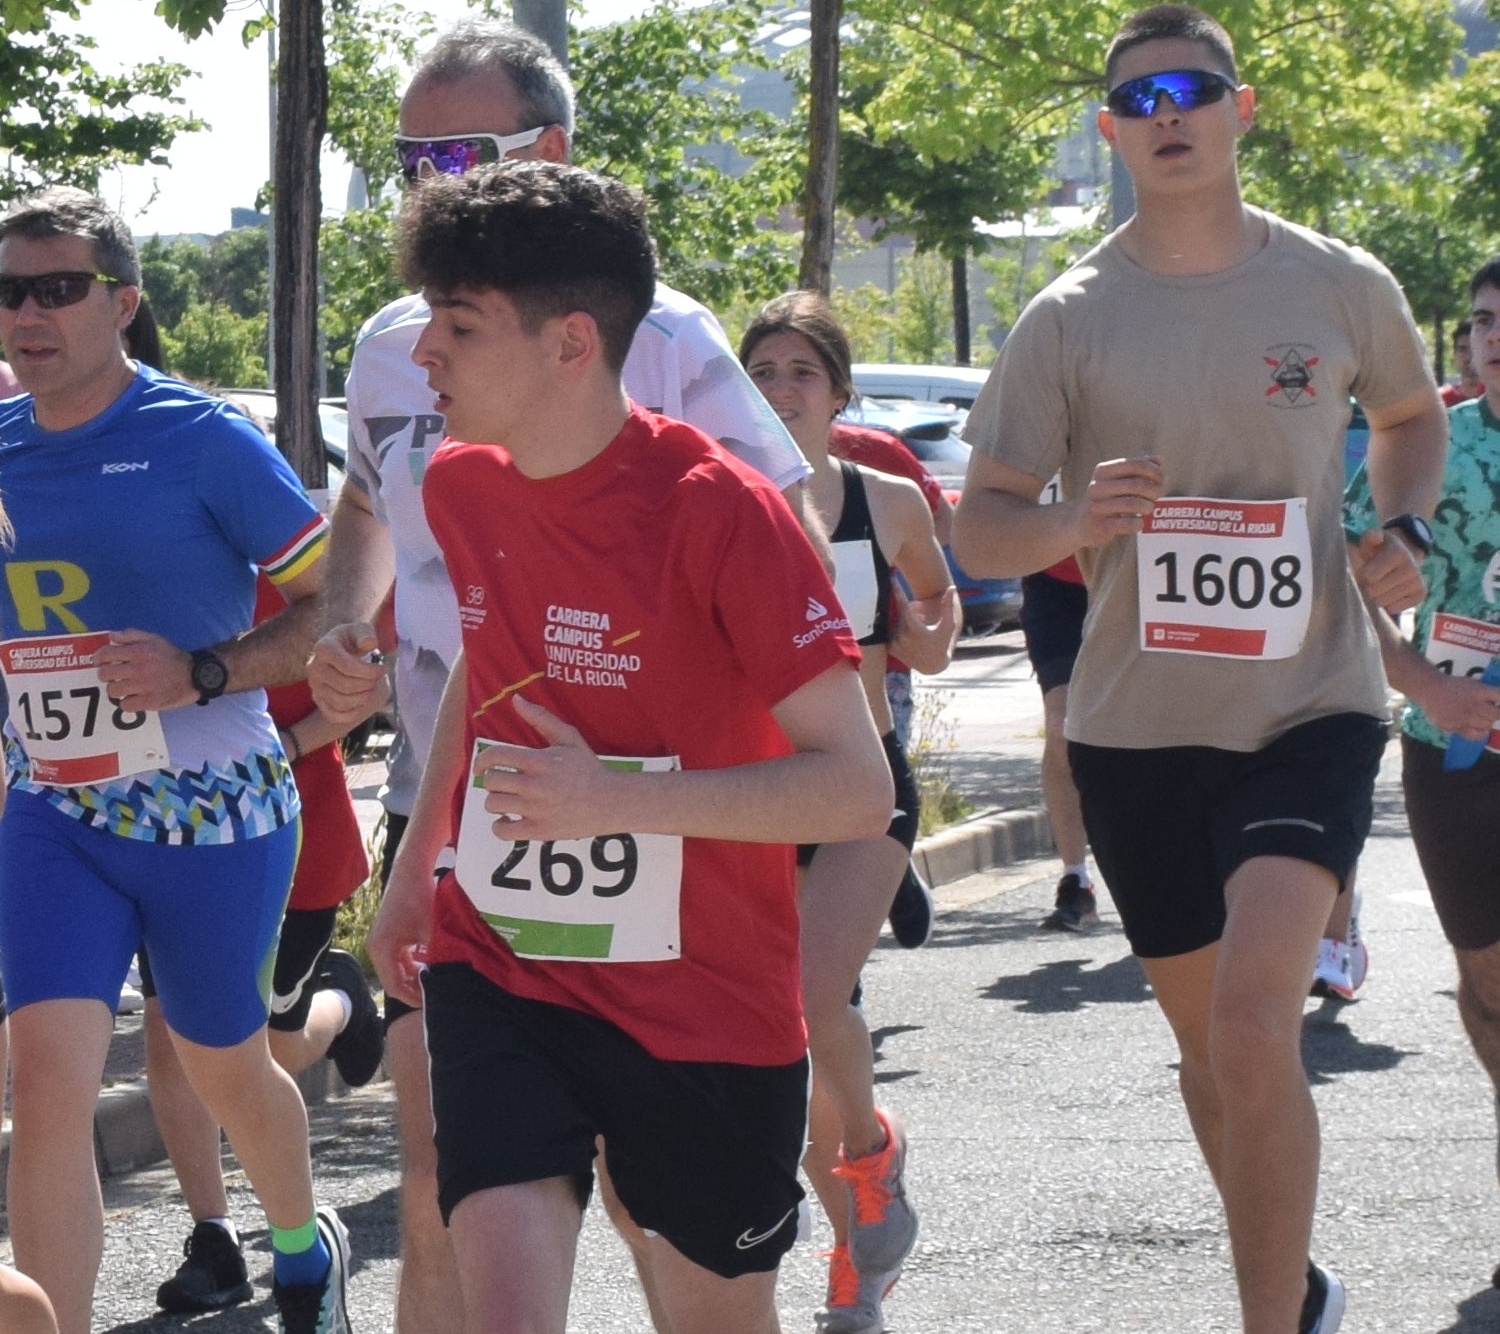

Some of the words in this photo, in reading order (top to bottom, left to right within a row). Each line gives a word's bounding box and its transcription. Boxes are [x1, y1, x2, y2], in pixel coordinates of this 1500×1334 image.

[1151, 519, 1218, 531] UNIVERSIDAD
[1219, 522, 1232, 533] DE
[1233, 523, 1246, 533] LA
[1247, 523, 1276, 534] RIOJA
[1153, 507, 1201, 519] CARRERA
[1202, 508, 1244, 521] CAMPUS
[1155, 551, 1302, 610] 1608
[5, 560, 90, 634] R
[547, 605, 611, 631] CARRERA
[42, 644, 74, 657] CAMPUS
[544, 624, 603, 650] CAMPUS
[545, 644, 641, 672] UNIVERSIDAD
[547, 662, 563, 680] DE
[564, 666, 584, 684] LA
[586, 670, 628, 690] RIOJA
[18, 687, 147, 741] 1578
[491, 832, 639, 898] 269
